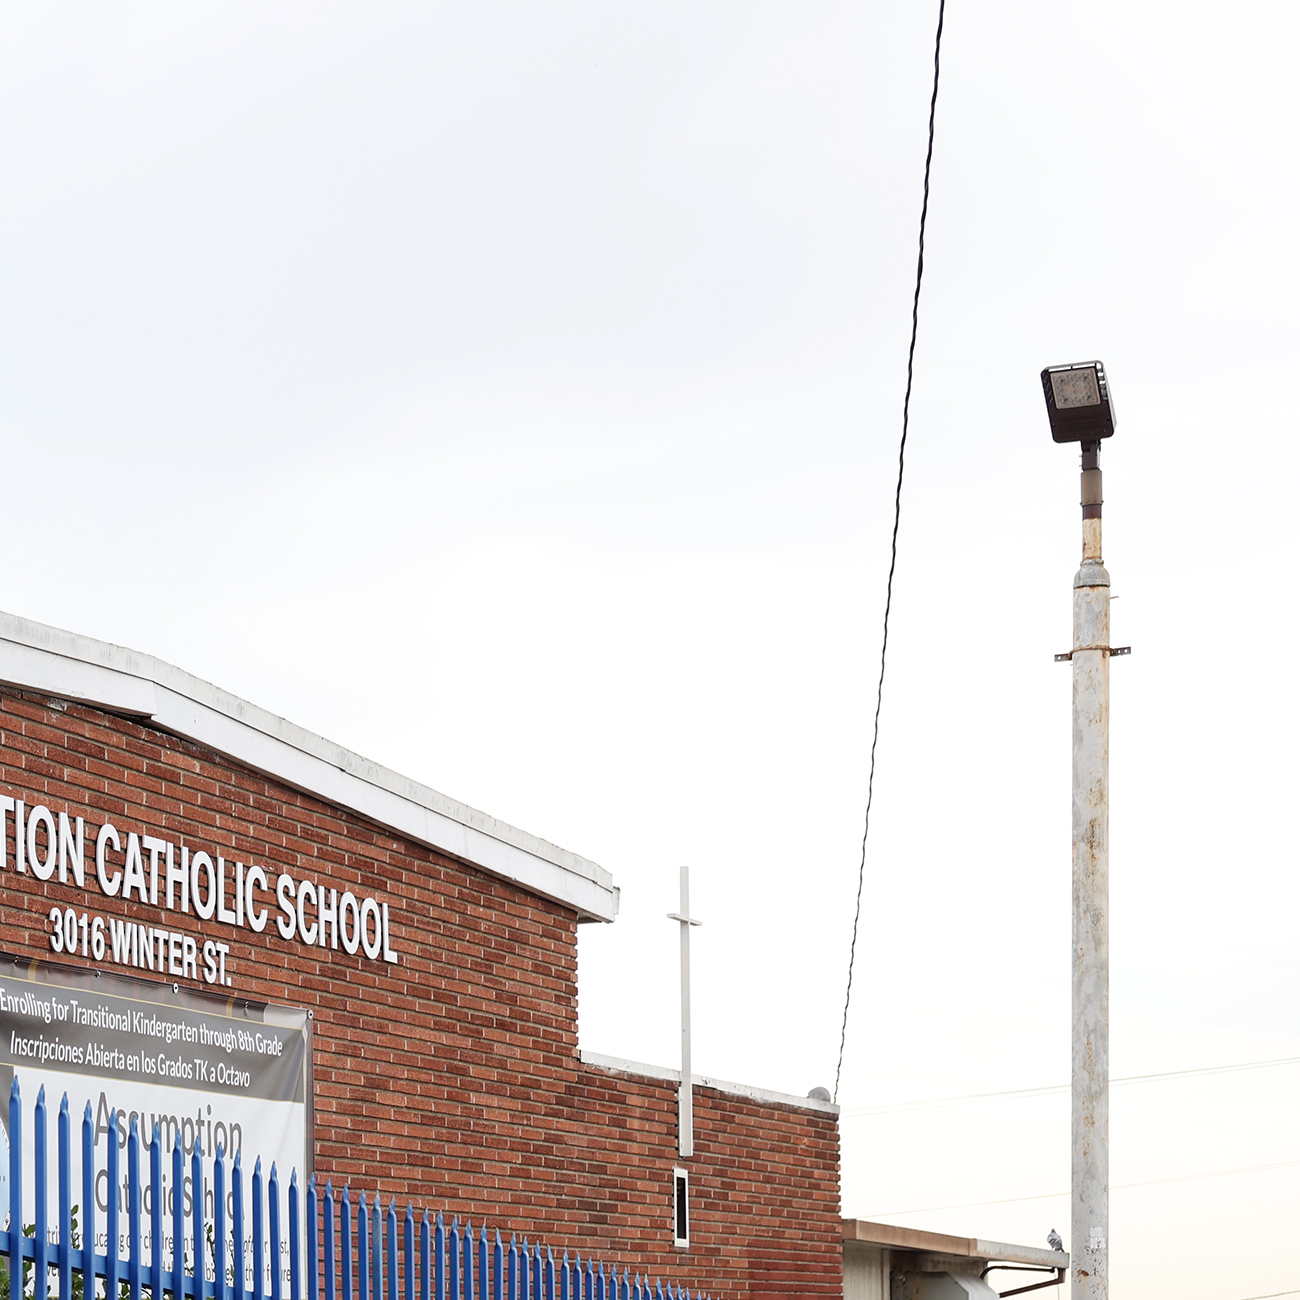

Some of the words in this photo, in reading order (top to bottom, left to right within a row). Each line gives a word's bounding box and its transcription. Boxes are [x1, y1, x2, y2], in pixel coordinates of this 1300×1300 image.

[95, 823, 268, 933] CATHOLIC
[276, 874, 398, 964] SCHOOL
[49, 907, 105, 961] 3016
[109, 918, 198, 980] WINTER
[202, 940, 232, 987] ST.
[10, 1030, 83, 1063] Inscripciones
[85, 1042, 125, 1071] Abierta
[126, 1053, 140, 1072] en
[141, 1050, 156, 1075] los
[157, 1053, 193, 1079] Grados
[194, 1059, 209, 1082] TK
[209, 1066, 216, 1083] a
[217, 1063, 250, 1088] Octavo
[51, 997, 70, 1021] for
[70, 1000, 131, 1033] Transitional
[132, 1011, 198, 1044] Kindergarten
[200, 1023, 238, 1053] through
[238, 1029, 255, 1052] 8th
[255, 1033, 283, 1057] Grade
[94, 1091, 243, 1167] Asumption
